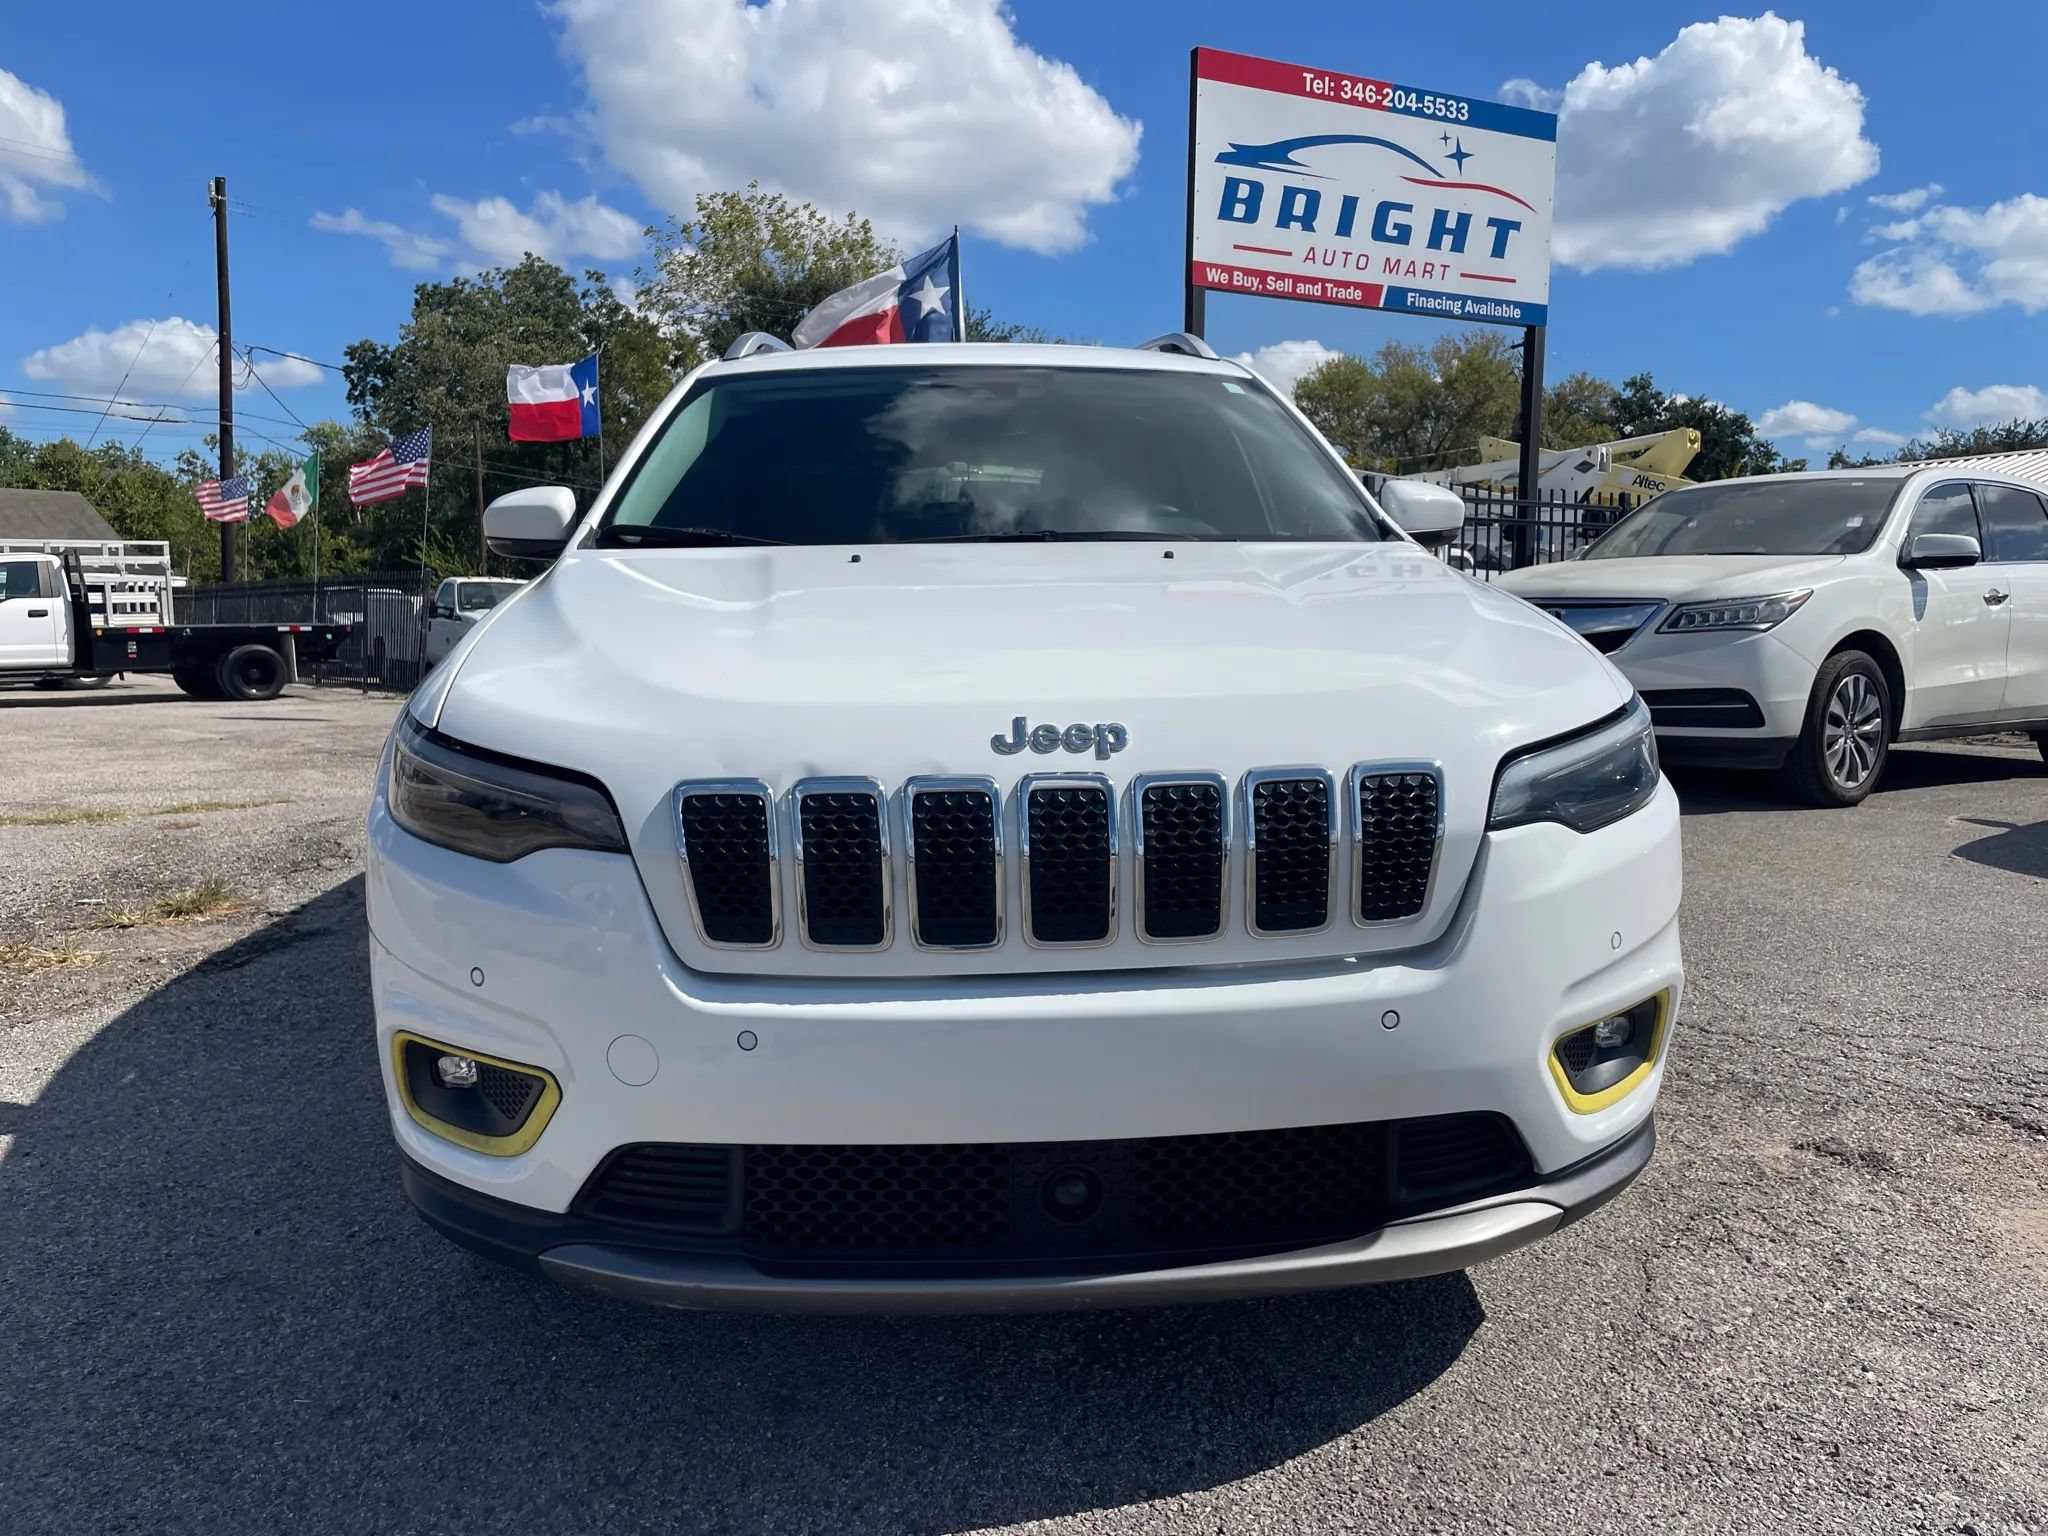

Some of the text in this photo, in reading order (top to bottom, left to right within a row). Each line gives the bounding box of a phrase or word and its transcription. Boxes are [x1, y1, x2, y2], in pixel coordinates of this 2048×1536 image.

[1303, 72, 1469, 121] Tel: 346-204-5533
[1217, 176, 1522, 259] BRIGHT
[1303, 246, 1451, 281] AUTO MART
[1206, 267, 1363, 300] We Buy, Sell and Trade
[1407, 292, 1521, 319] Finacing Available
[1631, 474, 1666, 492] Altec
[990, 716, 1129, 761] Jeep
